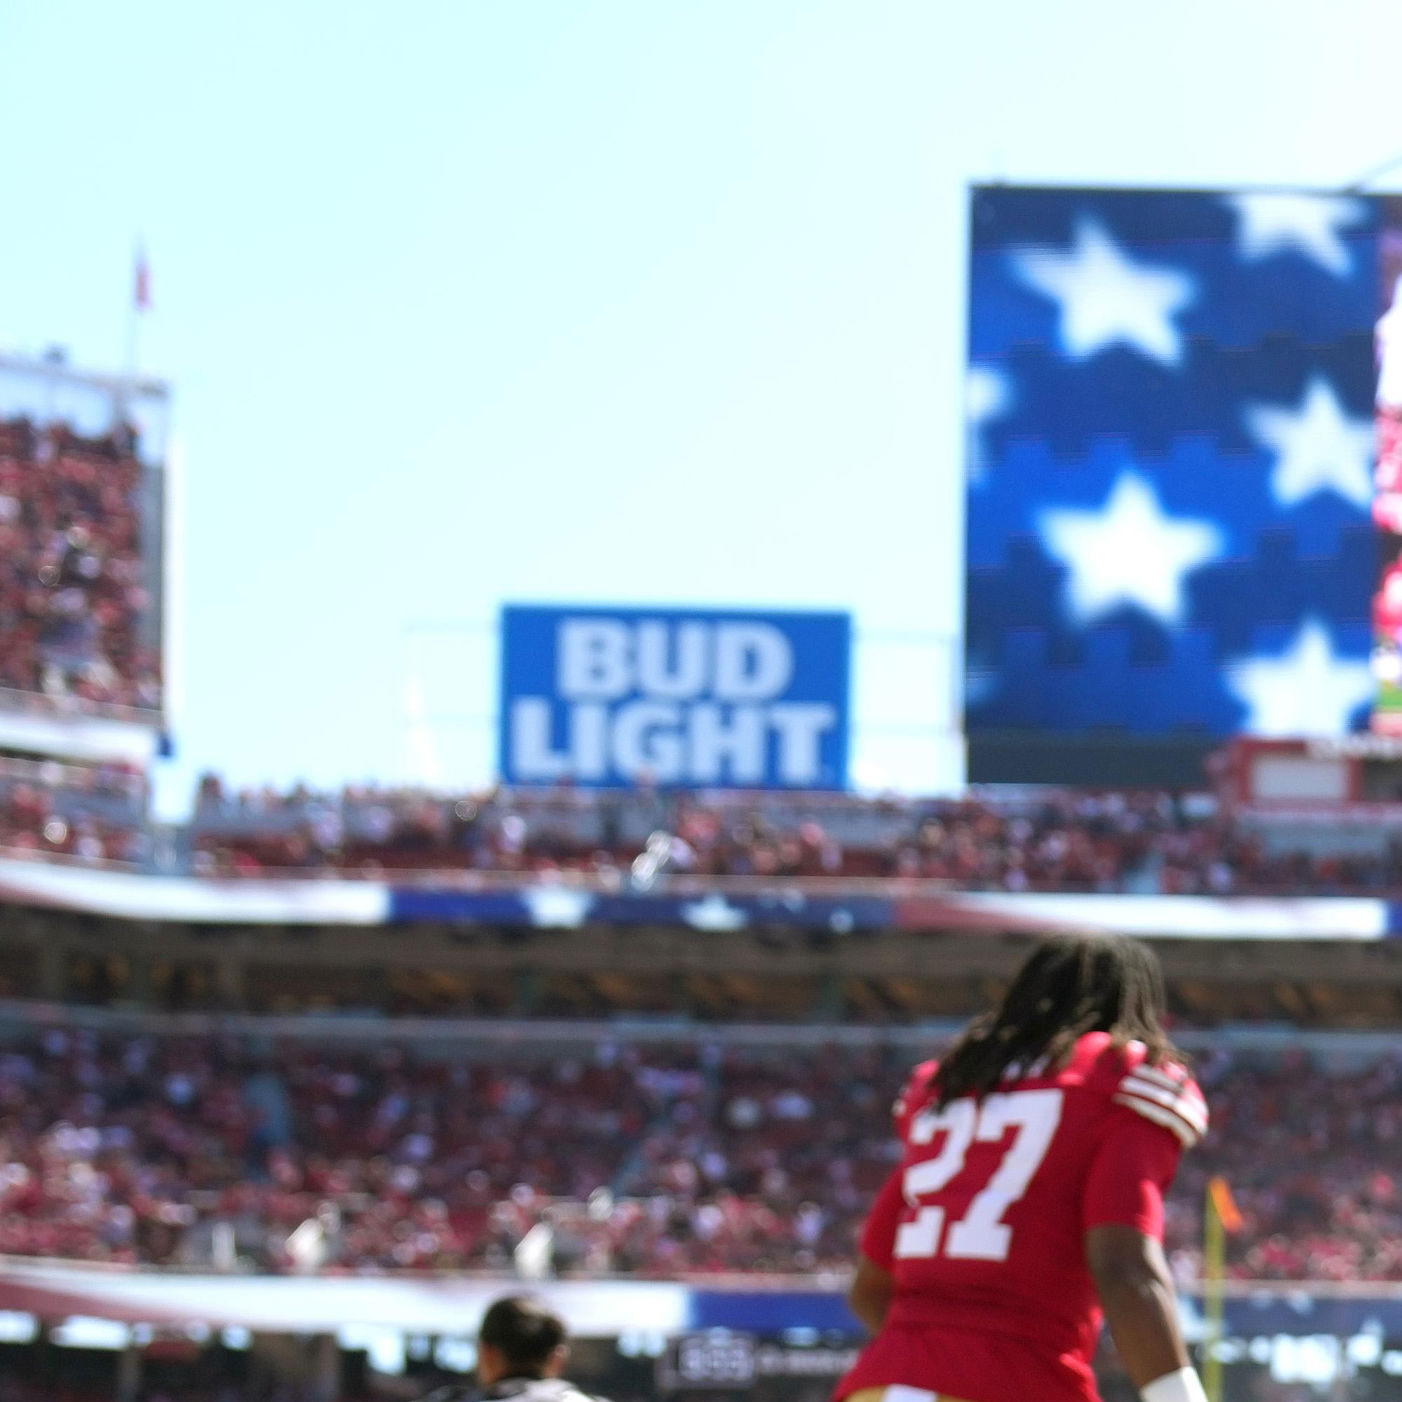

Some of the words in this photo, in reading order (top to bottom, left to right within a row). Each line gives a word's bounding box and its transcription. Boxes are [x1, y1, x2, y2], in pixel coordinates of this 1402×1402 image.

[557, 617, 794, 701] BUD
[511, 696, 838, 786] LIGHT
[893, 1087, 1065, 1263] 27
